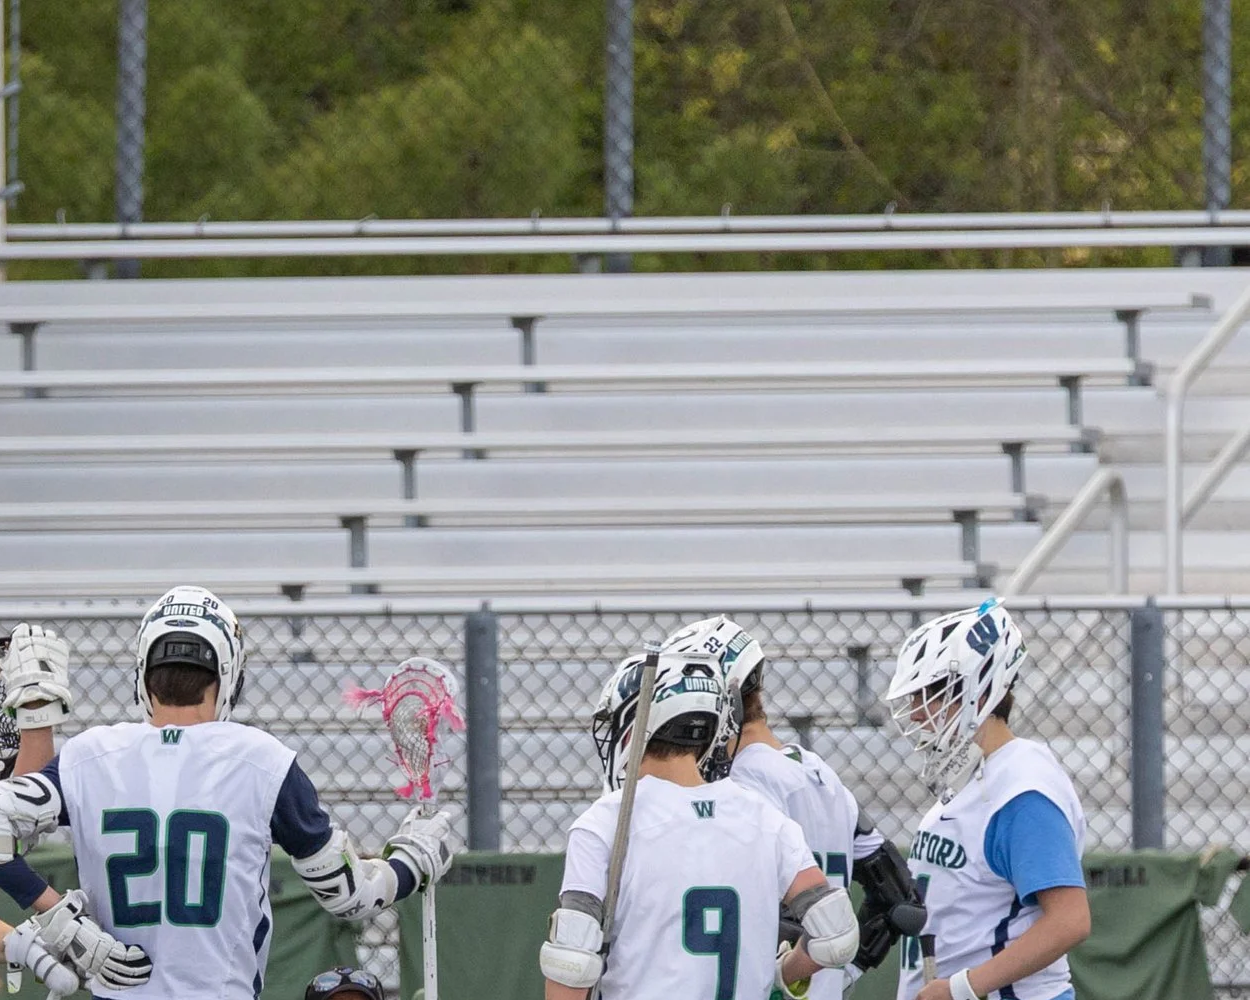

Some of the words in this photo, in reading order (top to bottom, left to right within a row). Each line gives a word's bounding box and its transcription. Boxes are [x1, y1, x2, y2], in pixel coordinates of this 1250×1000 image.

[162, 603, 207, 617] UNITED
[202, 596, 219, 610] 20
[702, 636, 723, 654] 22
[160, 728, 185, 745] W
[691, 800, 715, 819] W
[101, 808, 230, 928] 20
